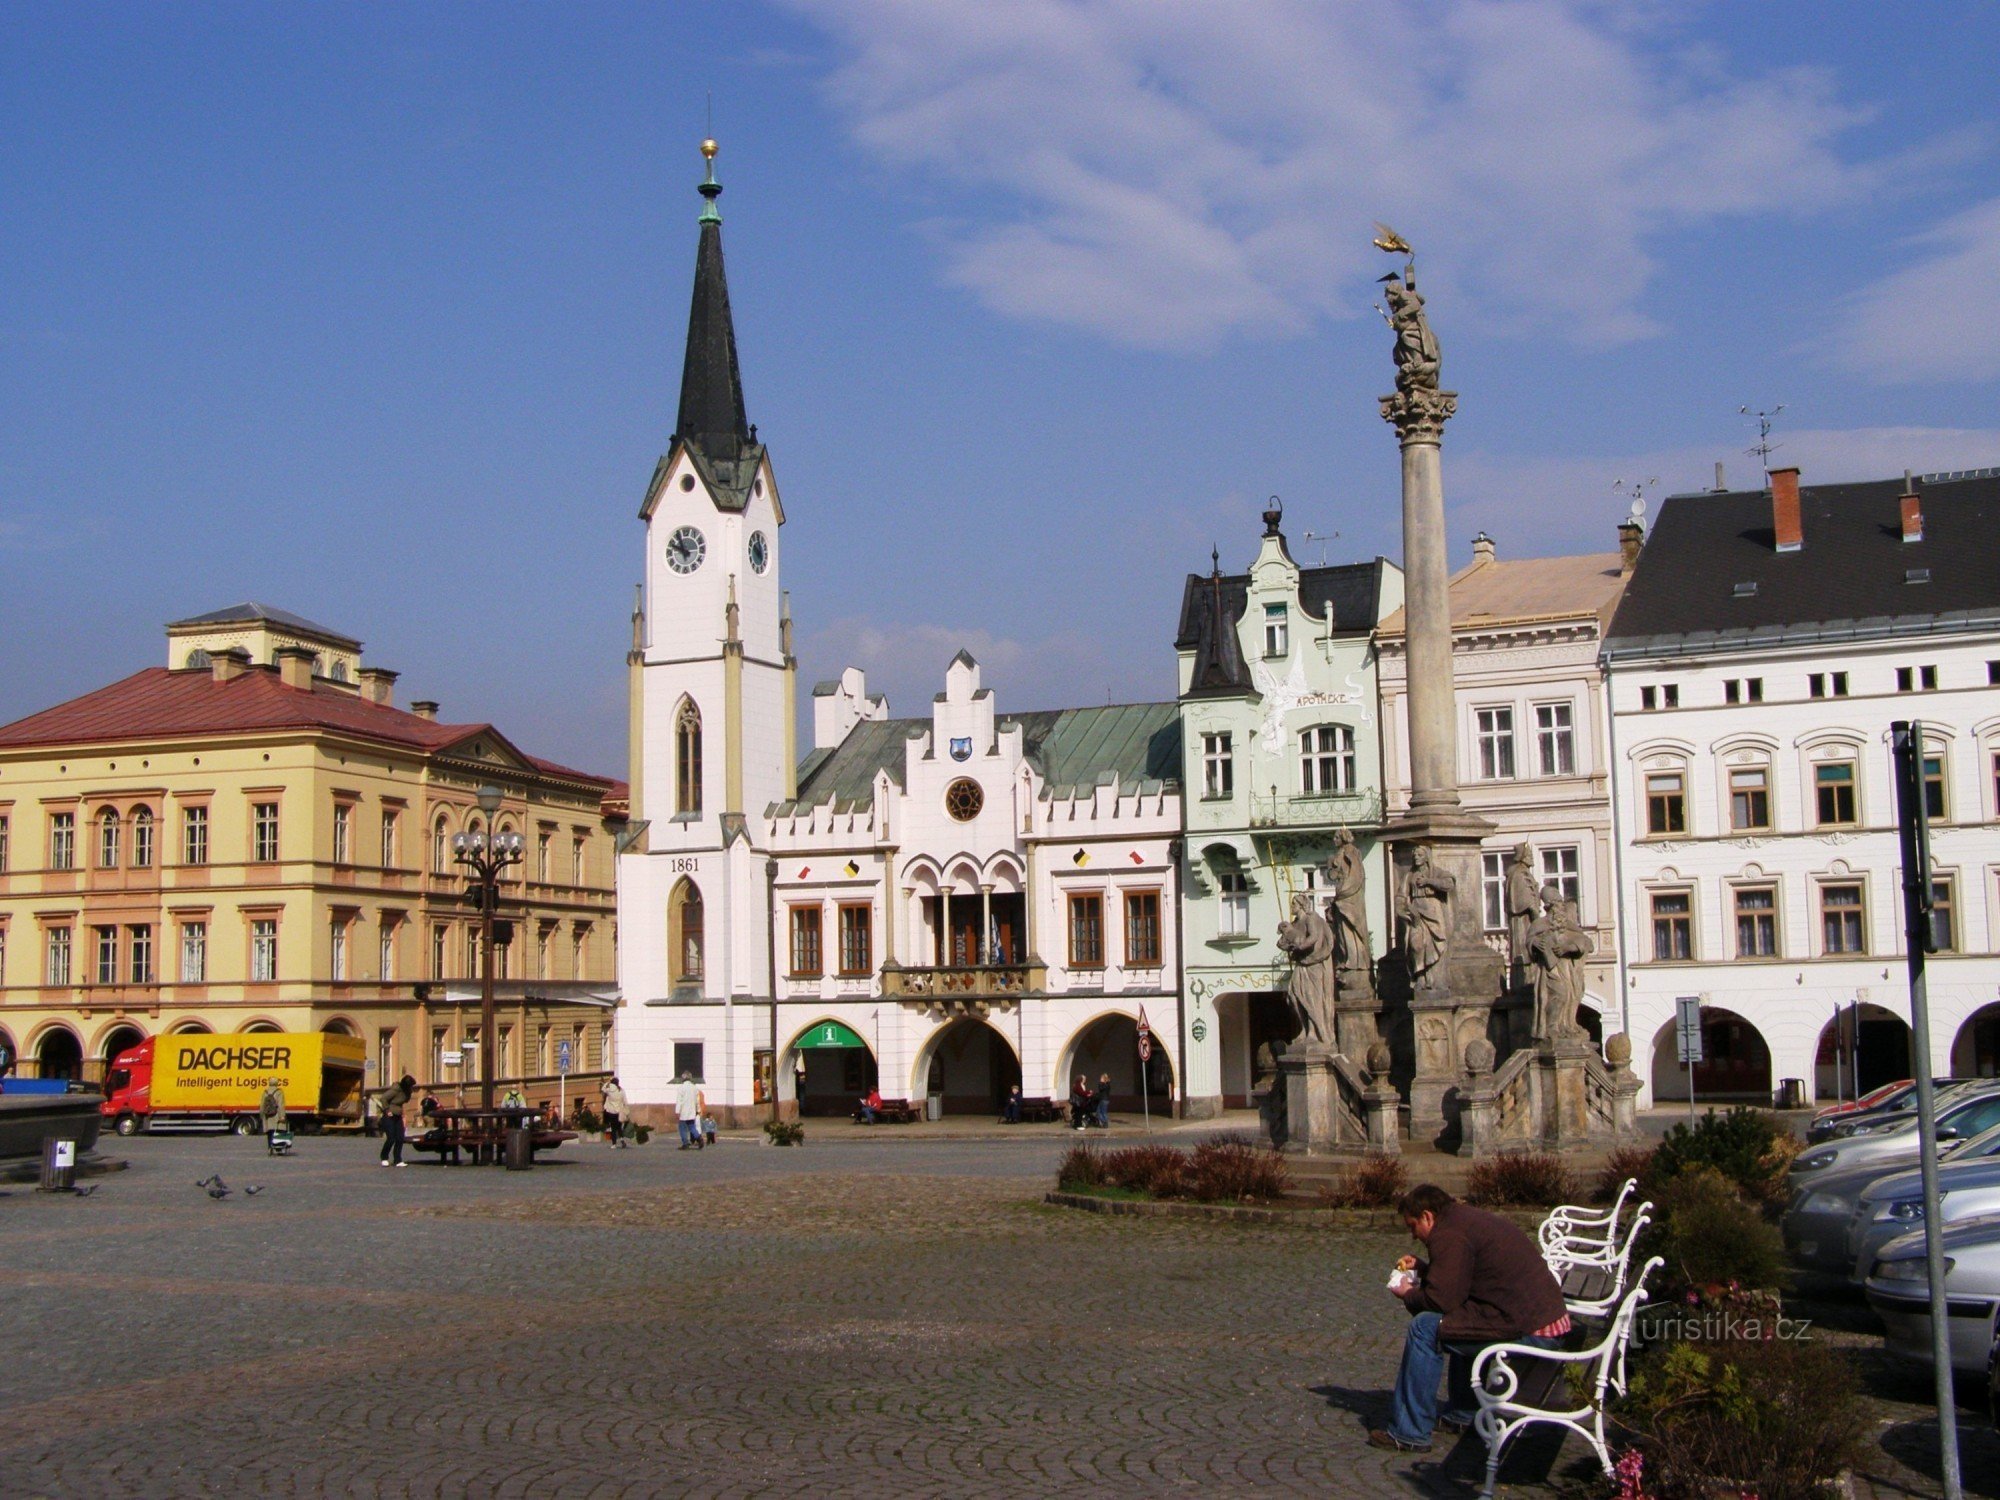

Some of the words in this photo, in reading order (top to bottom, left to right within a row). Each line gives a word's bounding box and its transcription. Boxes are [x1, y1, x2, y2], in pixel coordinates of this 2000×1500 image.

[1296, 693, 1347, 707] APOTHEKE
[671, 858, 699, 872] 1861
[178, 1047, 291, 1070] DACHSER
[176, 1076, 233, 1090] Intelligent
[236, 1076, 289, 1090] Logiscs
